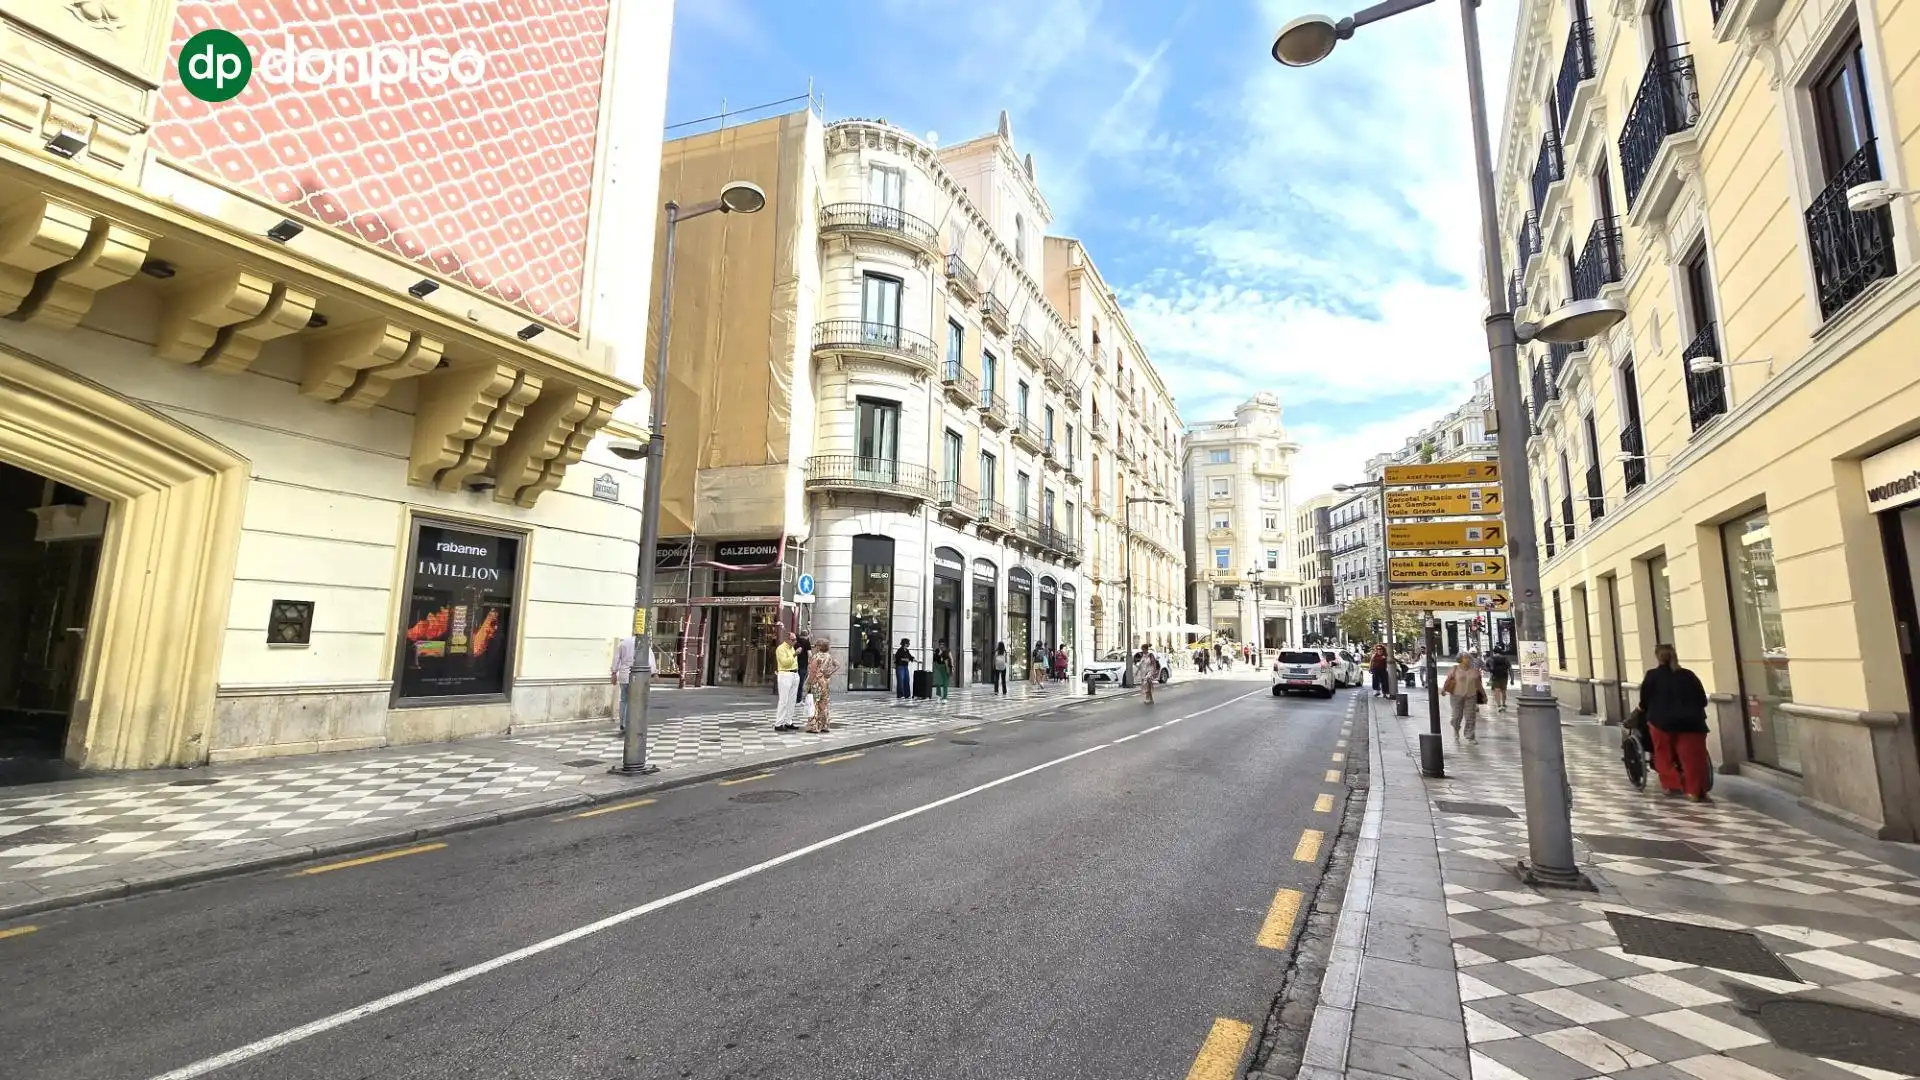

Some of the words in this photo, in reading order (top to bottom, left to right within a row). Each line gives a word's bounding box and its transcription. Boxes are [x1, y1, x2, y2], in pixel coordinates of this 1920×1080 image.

[436, 542, 488, 557] rabanne
[720, 545, 778, 557] CALZEDONIA
[1392, 560, 1414, 568] Hotel
[427, 562, 500, 581] MILLION
[1392, 569, 1428, 577] Carmen
[1431, 569, 1472, 577] Granada
[1391, 599, 1427, 607] Eurostars
[1430, 599, 1455, 607] Puerta
